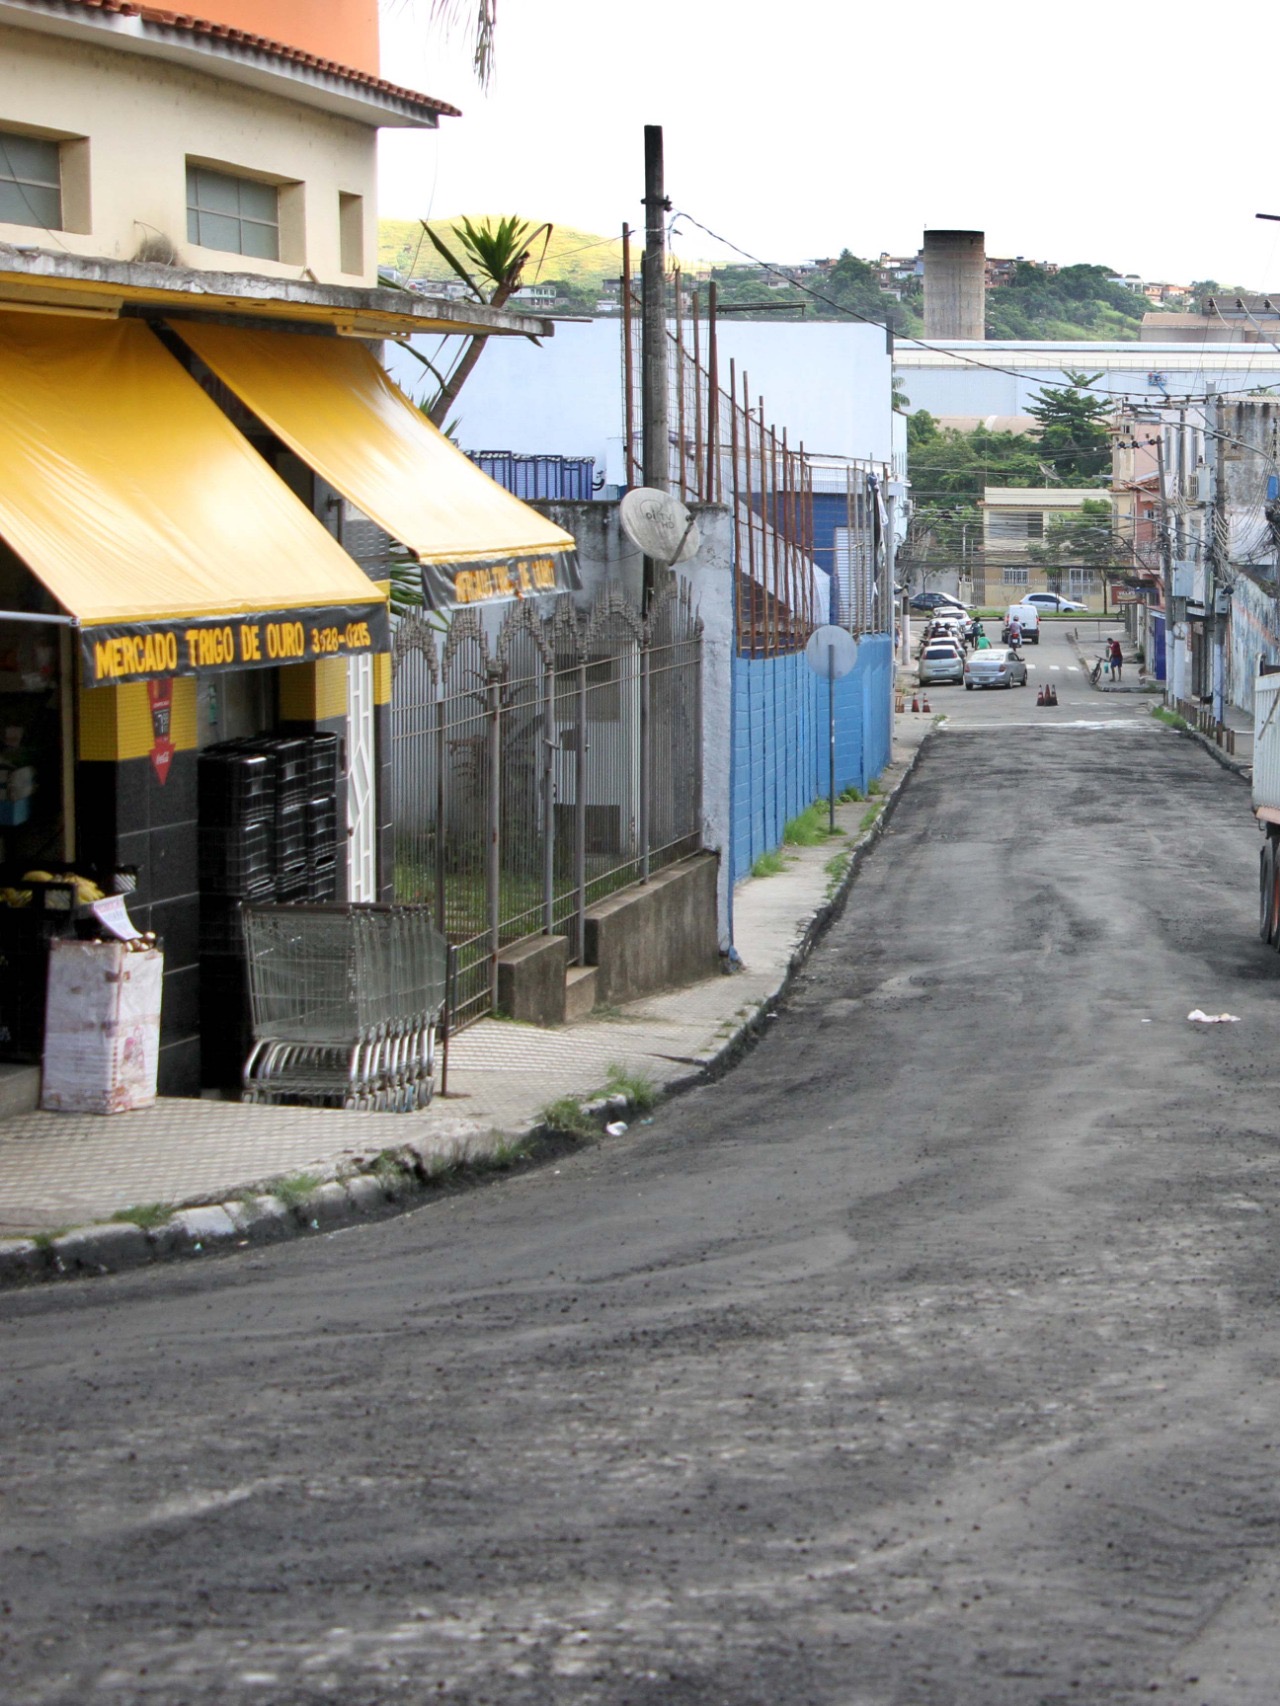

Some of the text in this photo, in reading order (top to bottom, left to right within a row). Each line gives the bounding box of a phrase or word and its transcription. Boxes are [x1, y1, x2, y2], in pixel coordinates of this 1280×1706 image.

[95, 631, 178, 680] MERCADO
[185, 626, 234, 667] TRIGO
[240, 624, 261, 661] DE
[266, 621, 305, 659] OURO
